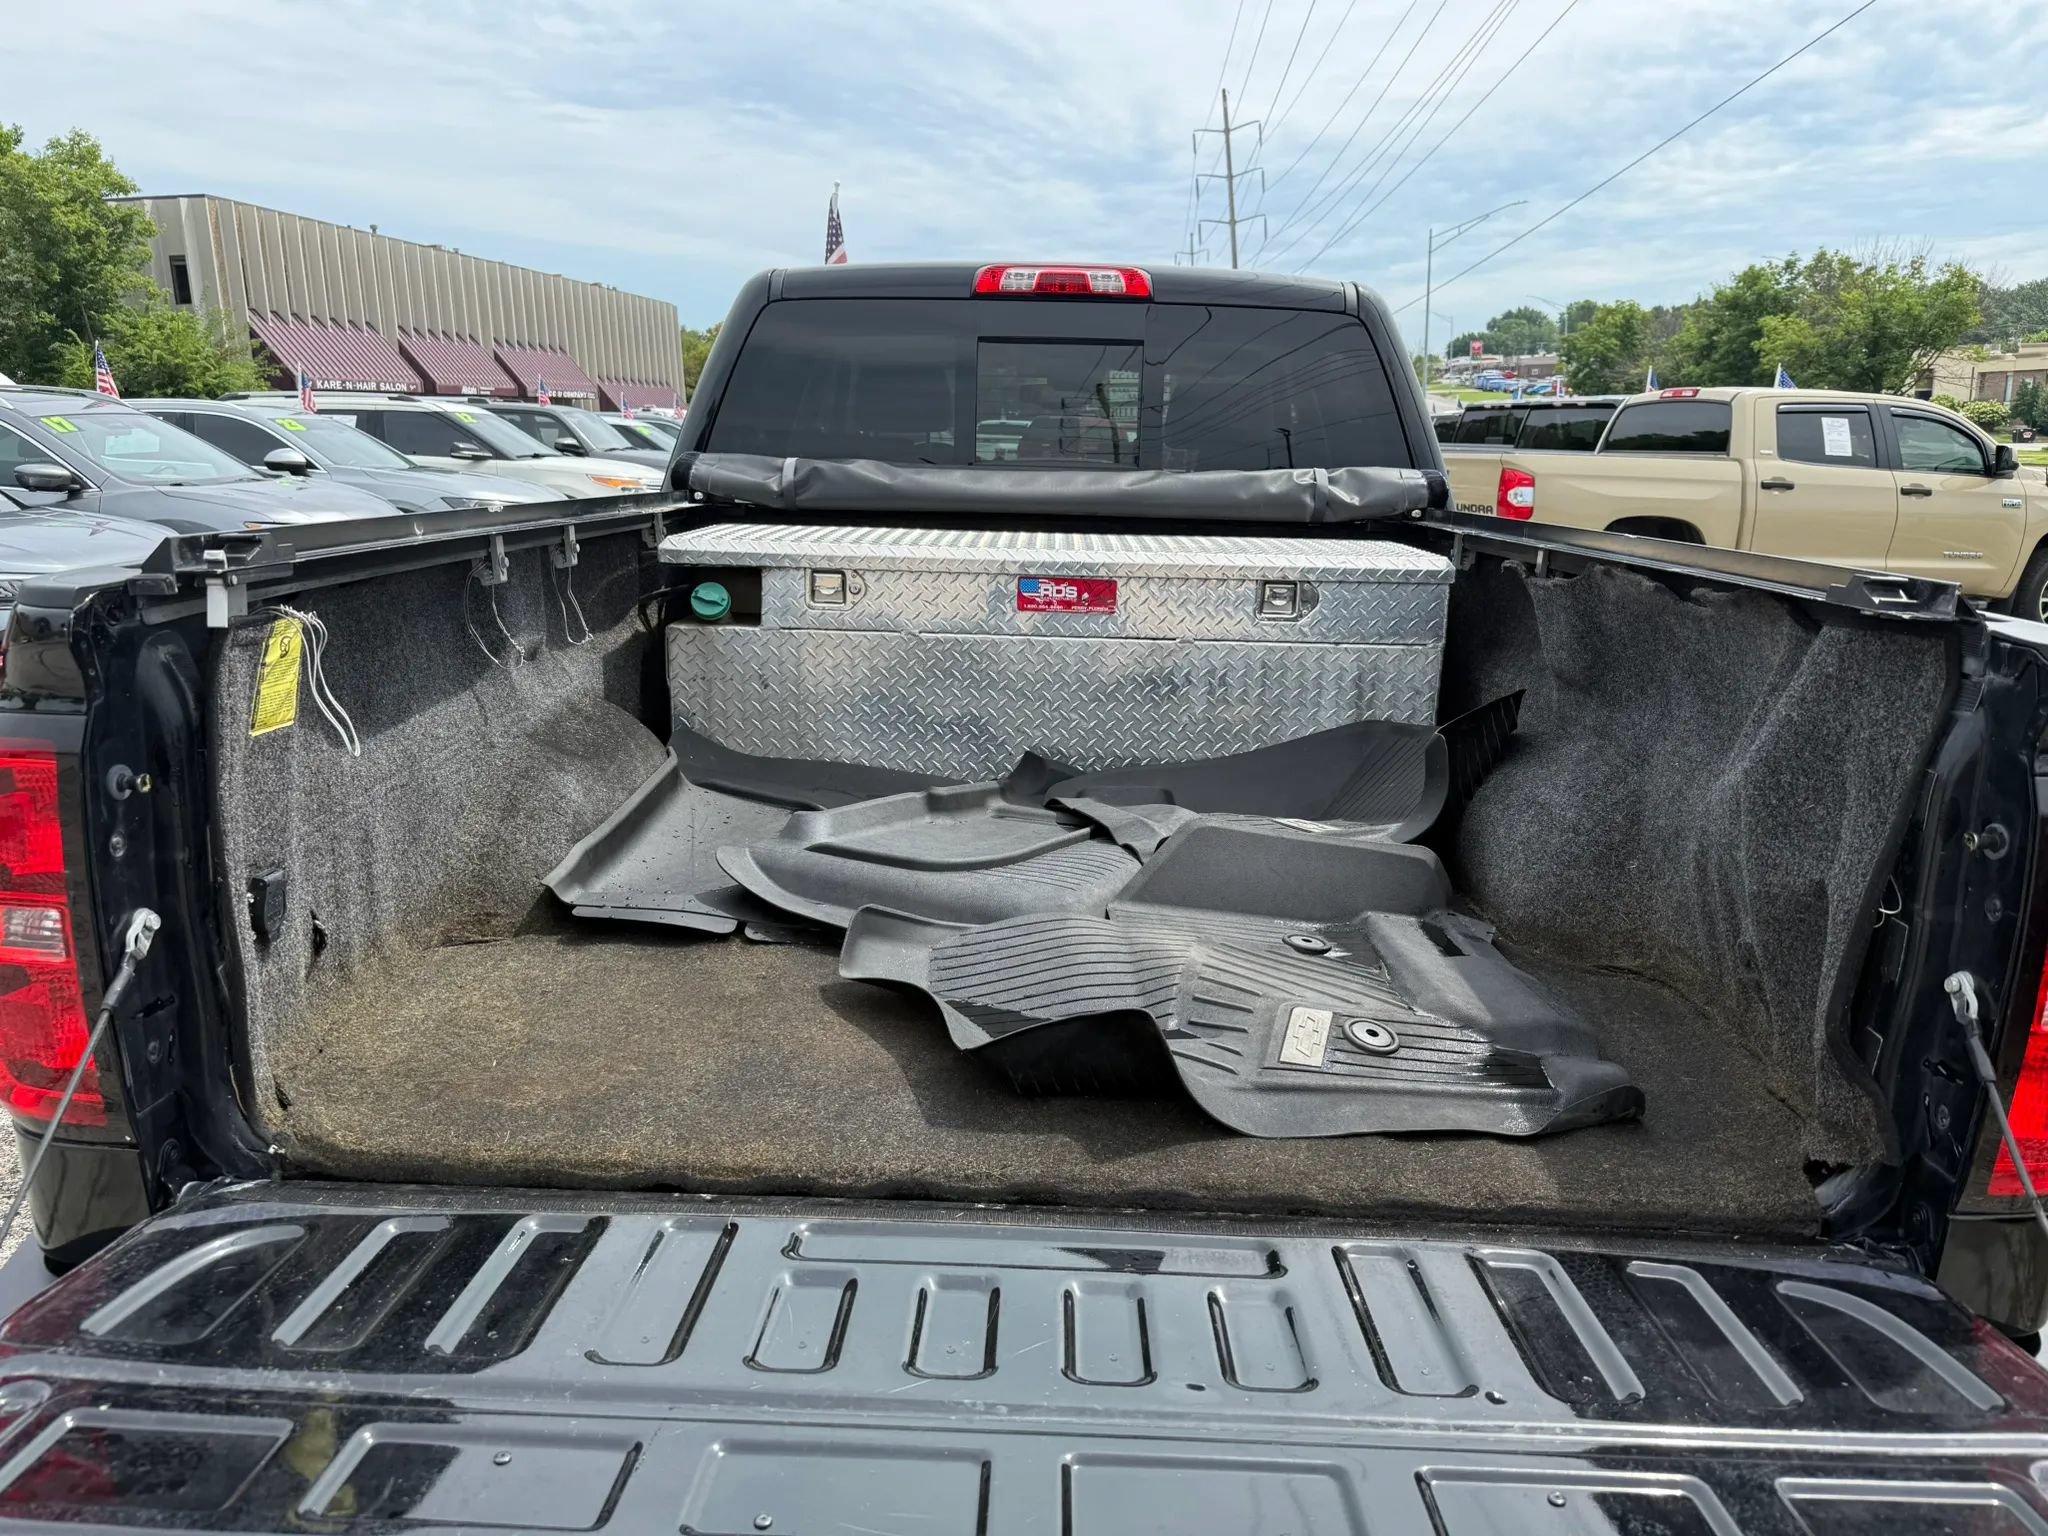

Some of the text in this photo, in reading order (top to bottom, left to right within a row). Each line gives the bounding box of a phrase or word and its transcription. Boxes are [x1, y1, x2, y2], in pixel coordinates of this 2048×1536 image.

[380, 382, 408, 392] SALON
[1456, 503, 1494, 514] UNDRA
[1040, 583, 1078, 598] RDS
